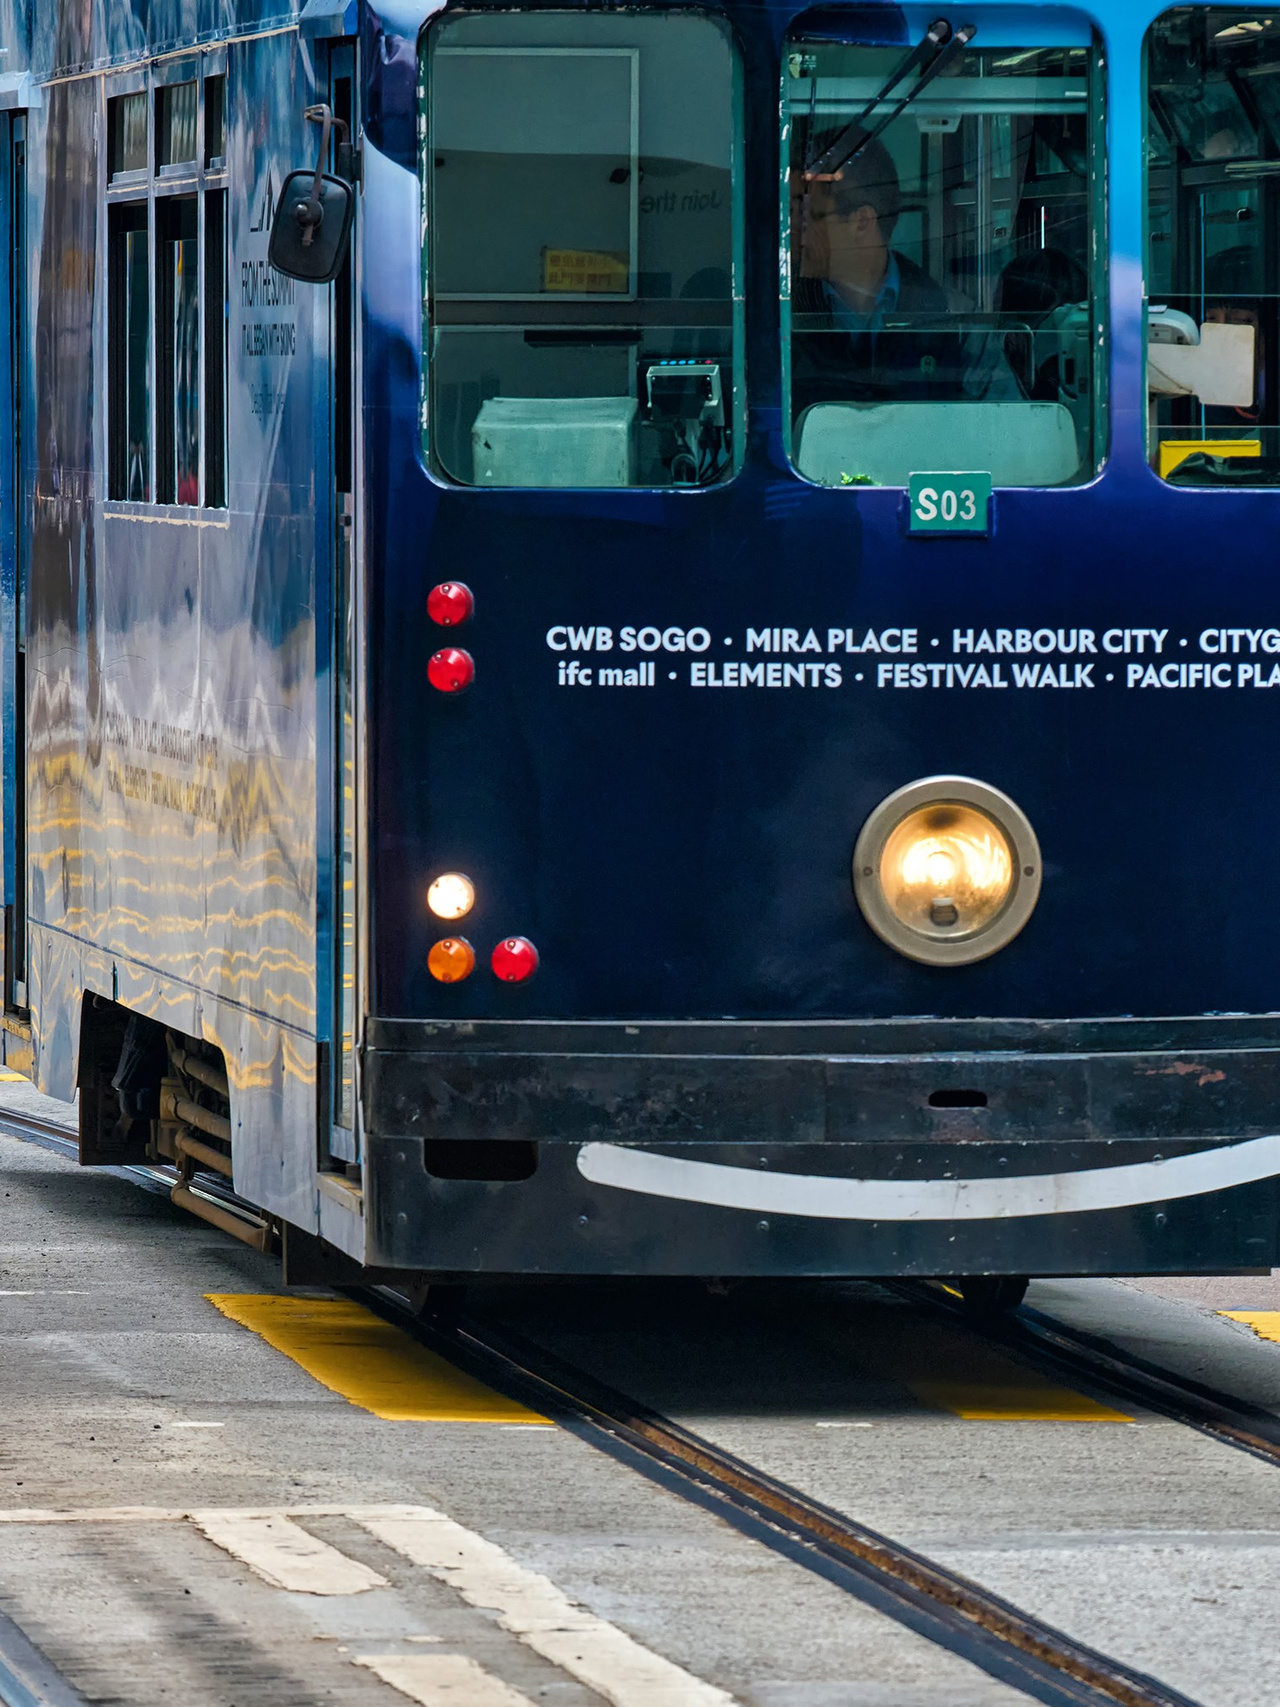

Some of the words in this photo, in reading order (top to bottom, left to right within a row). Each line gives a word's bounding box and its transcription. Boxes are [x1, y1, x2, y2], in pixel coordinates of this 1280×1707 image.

[915, 487, 976, 521] S03
[545, 625, 614, 651] CWB
[619, 626, 711, 653] SOGO
[746, 627, 823, 653] MIRA
[827, 628, 918, 654] PLACE
[952, 628, 1099, 654] HARBOUR
[1103, 628, 1169, 654] CITY
[1199, 628, 1280, 654] CITYG
[558, 660, 593, 686] ifc
[598, 661, 655, 687] mall
[690, 662, 843, 688] ELEMENTS
[877, 663, 1009, 689] FESTIVAL
[1011, 663, 1095, 688] WALK
[1126, 663, 1232, 688] PACIFIC
[1237, 663, 1280, 688] PLA
